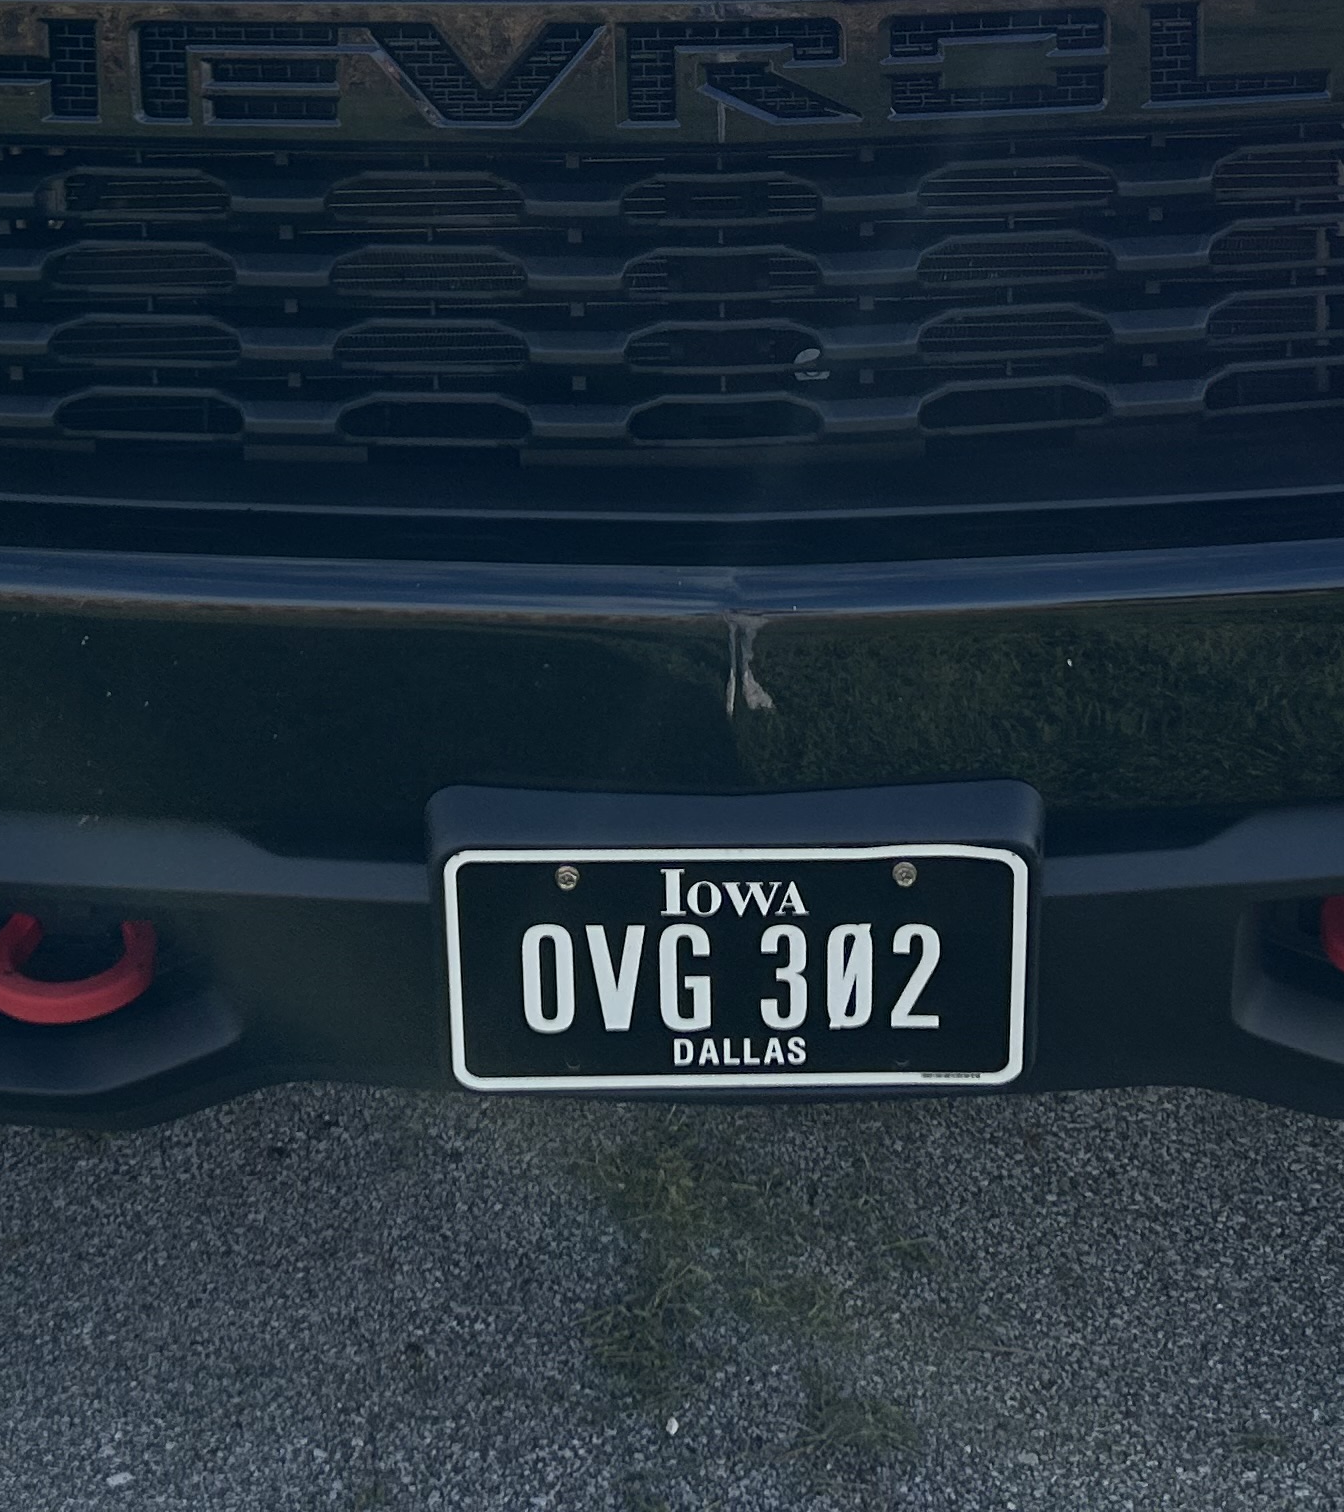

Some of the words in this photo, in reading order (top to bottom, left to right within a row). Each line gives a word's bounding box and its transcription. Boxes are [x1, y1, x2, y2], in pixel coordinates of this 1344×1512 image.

[521, 922, 712, 1034] OVG
[759, 922, 942, 1031] 302
[673, 1036, 808, 1067] DALLAS
